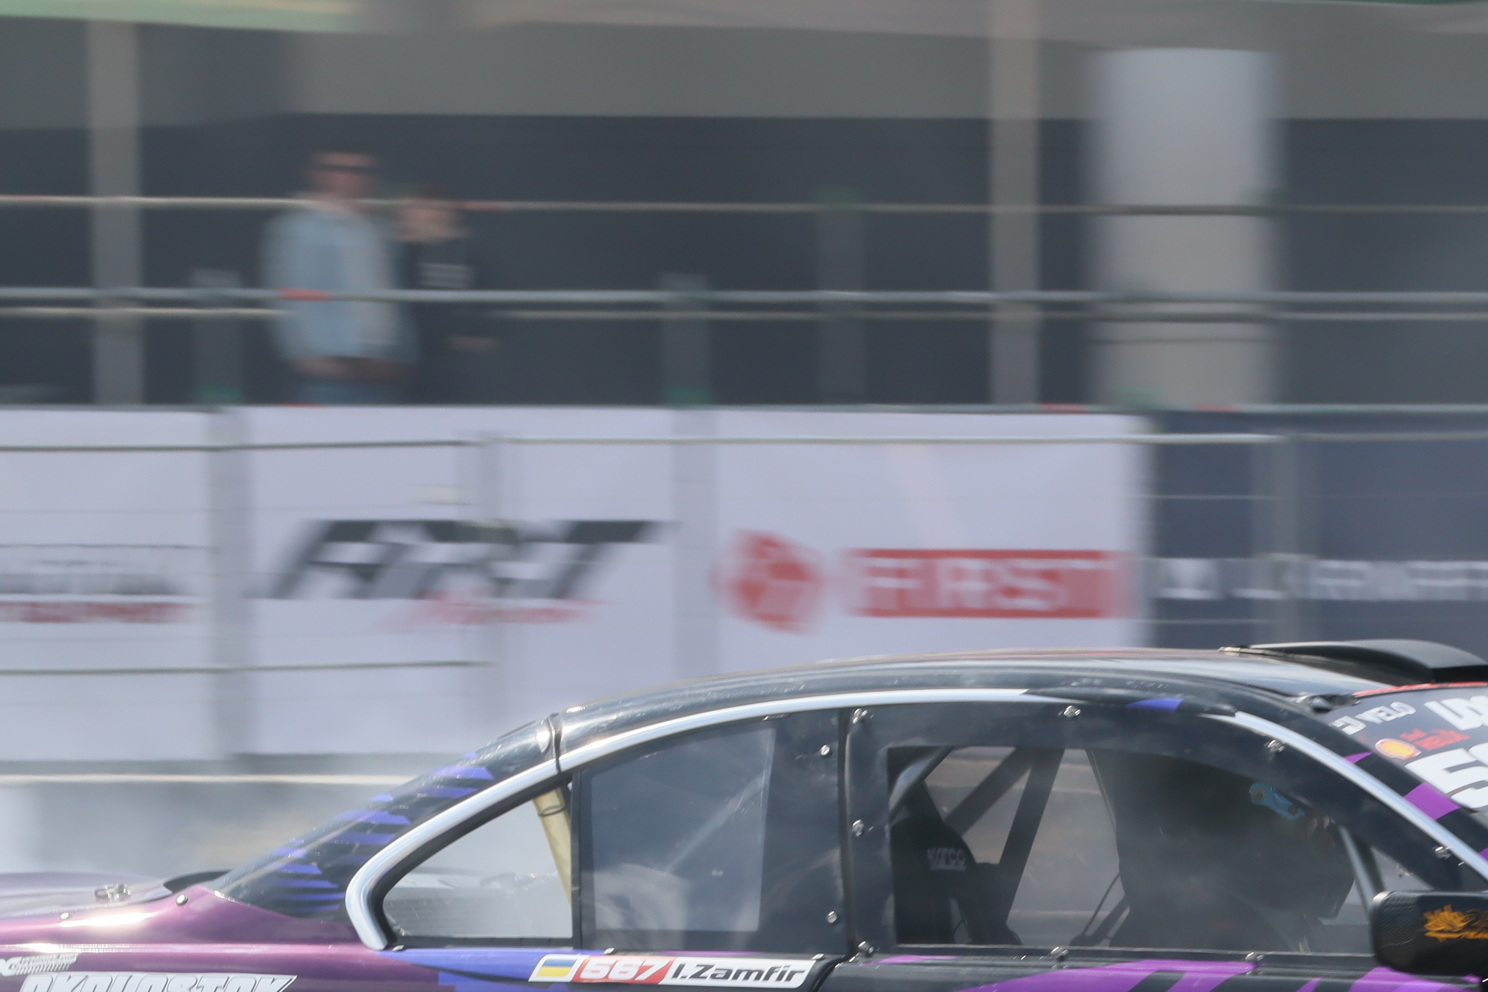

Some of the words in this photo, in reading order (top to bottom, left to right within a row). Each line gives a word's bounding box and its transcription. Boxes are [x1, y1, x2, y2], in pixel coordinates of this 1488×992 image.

[860, 557, 1114, 610] FIRST
[579, 959, 658, 982] 567
[672, 963, 805, 982] I.Zamfir
